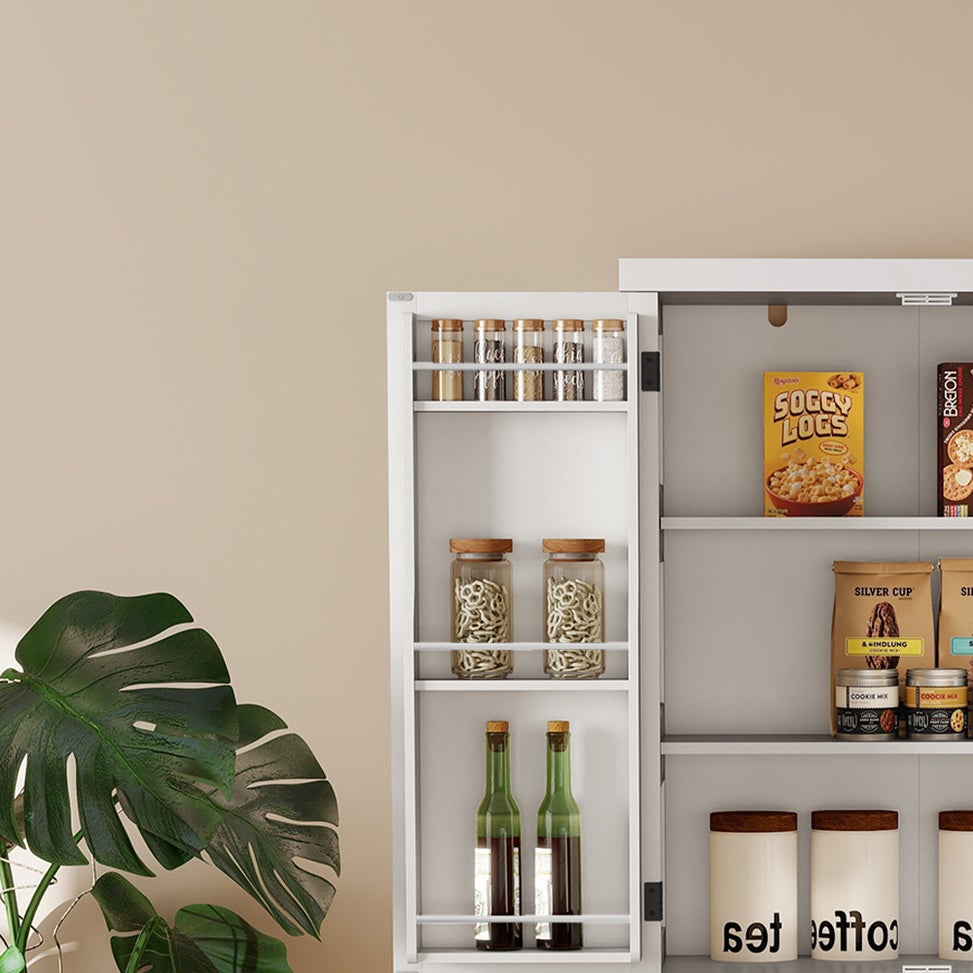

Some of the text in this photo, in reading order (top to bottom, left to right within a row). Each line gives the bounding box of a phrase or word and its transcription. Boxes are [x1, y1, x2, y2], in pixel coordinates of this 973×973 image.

[773, 389, 852, 423] SOGGY
[781, 414, 849, 447] LOGS
[854, 587, 913, 596] SILVER CUP
